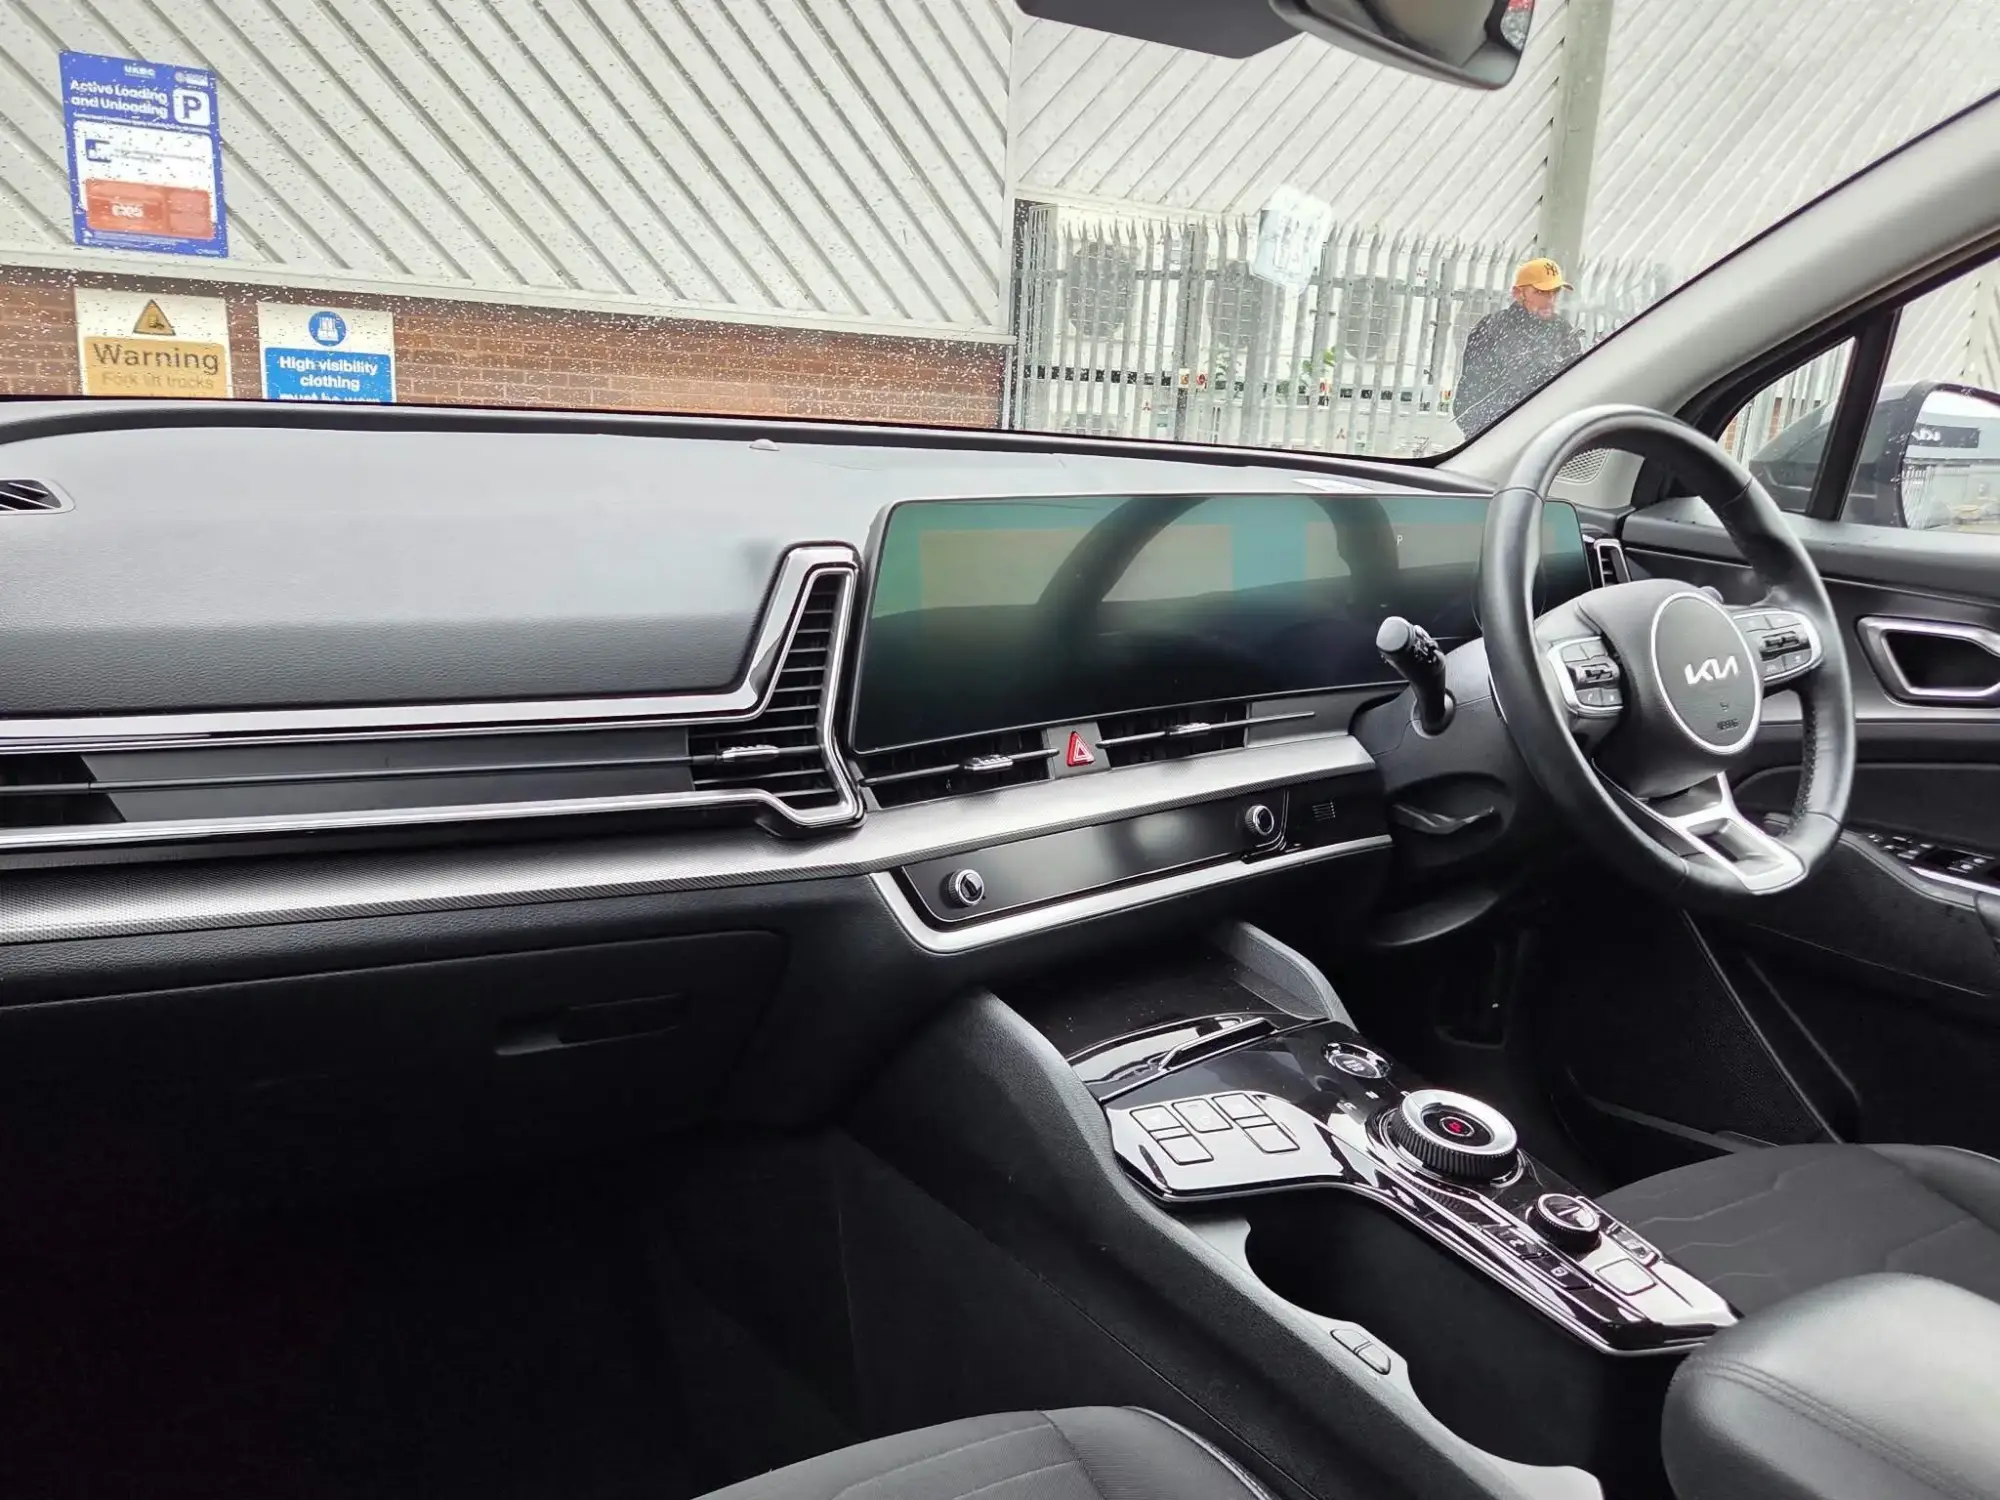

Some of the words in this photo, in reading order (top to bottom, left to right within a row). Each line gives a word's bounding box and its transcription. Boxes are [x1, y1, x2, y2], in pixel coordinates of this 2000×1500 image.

[70, 80, 114, 95] Active
[115, 85, 168, 105] Loading
[70, 97, 99, 108] and
[101, 98, 168, 120] Unloading
[182, 95, 202, 119] P
[93, 343, 219, 375] Warning
[280, 356, 316, 372] High
[318, 359, 378, 376] visibility
[101, 371, 139, 386] Fork
[166, 376, 215, 389] trucks
[300, 374, 360, 392] clothing
[1397, 535, 1403, 546] P
[1684, 655, 1739, 685] KIA
